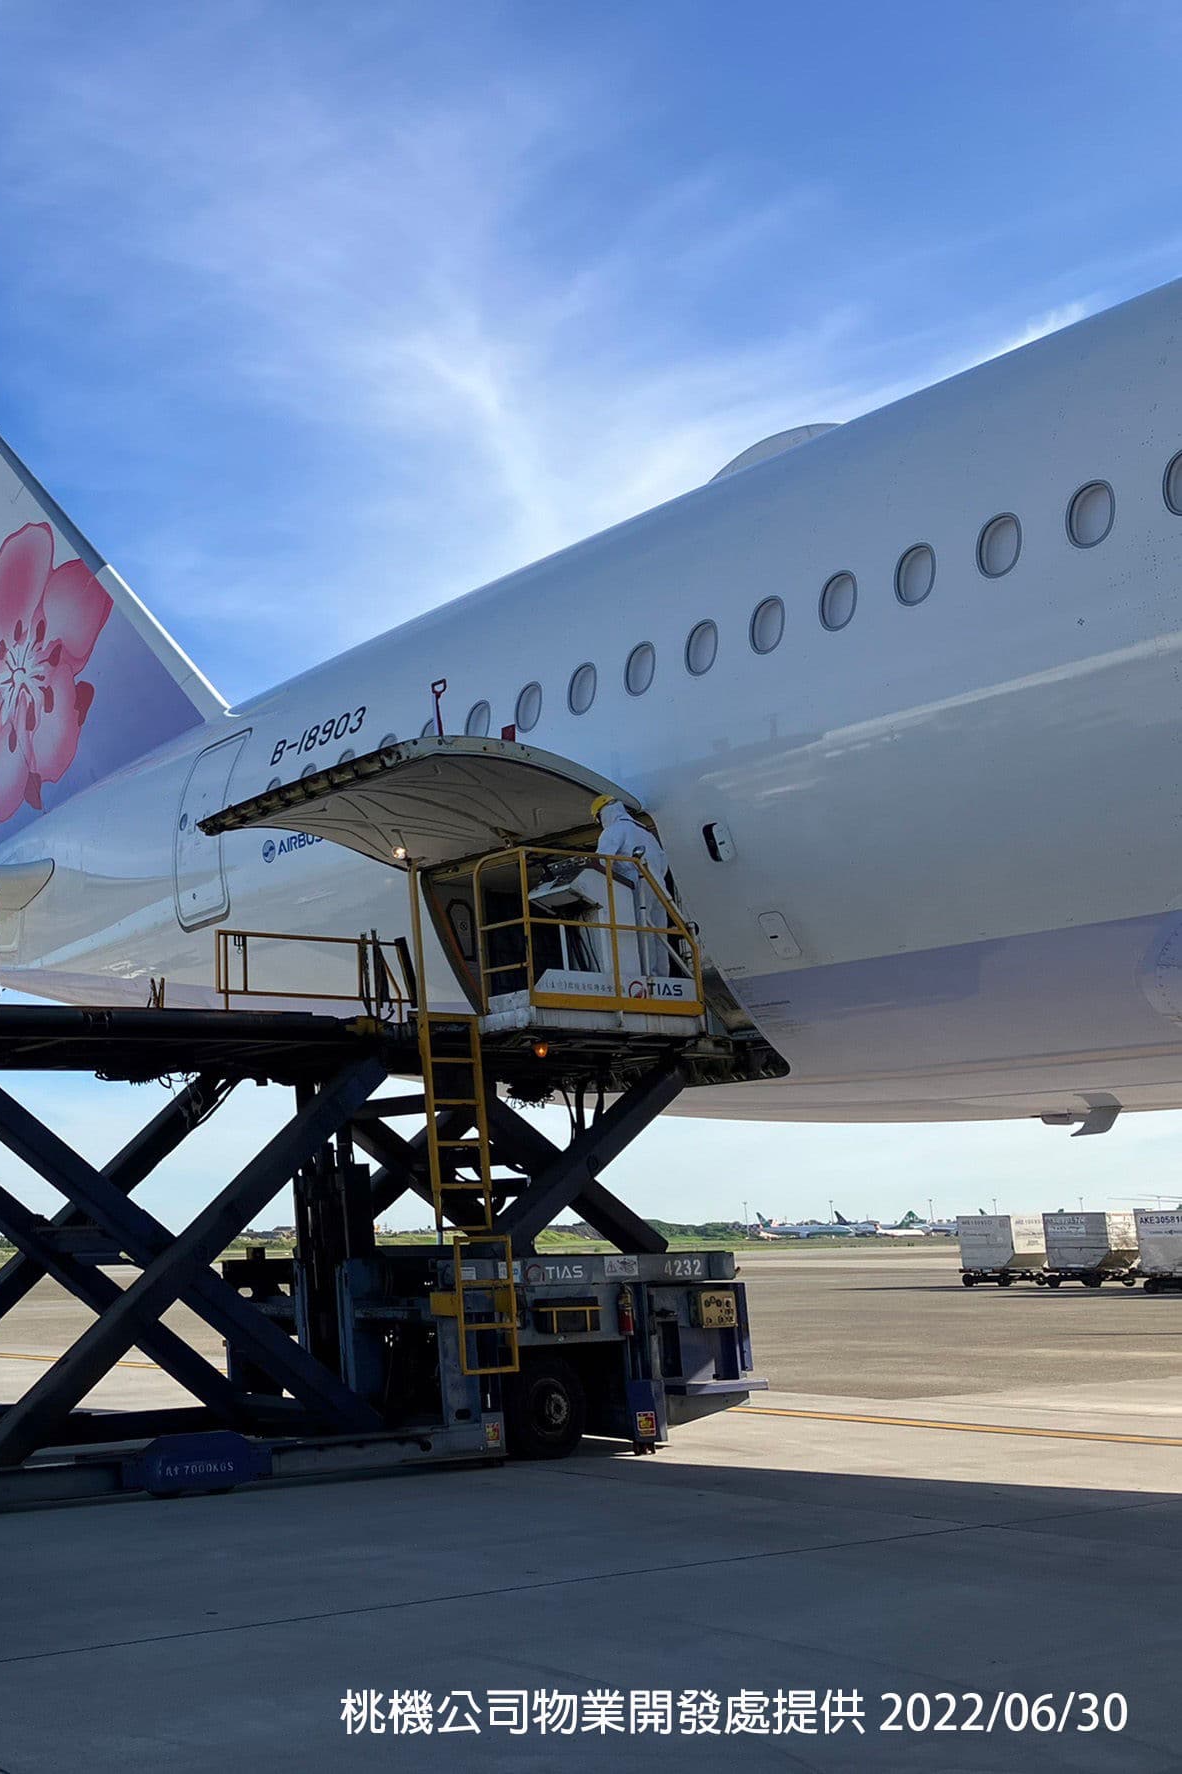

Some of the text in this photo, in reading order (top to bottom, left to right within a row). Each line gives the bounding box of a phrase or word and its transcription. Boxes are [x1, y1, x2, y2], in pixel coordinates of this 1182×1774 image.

[270, 706, 366, 766] B-18903
[648, 983, 683, 996] TIAS
[545, 1265, 584, 1279] TIAS
[664, 1258, 703, 1276] 4232
